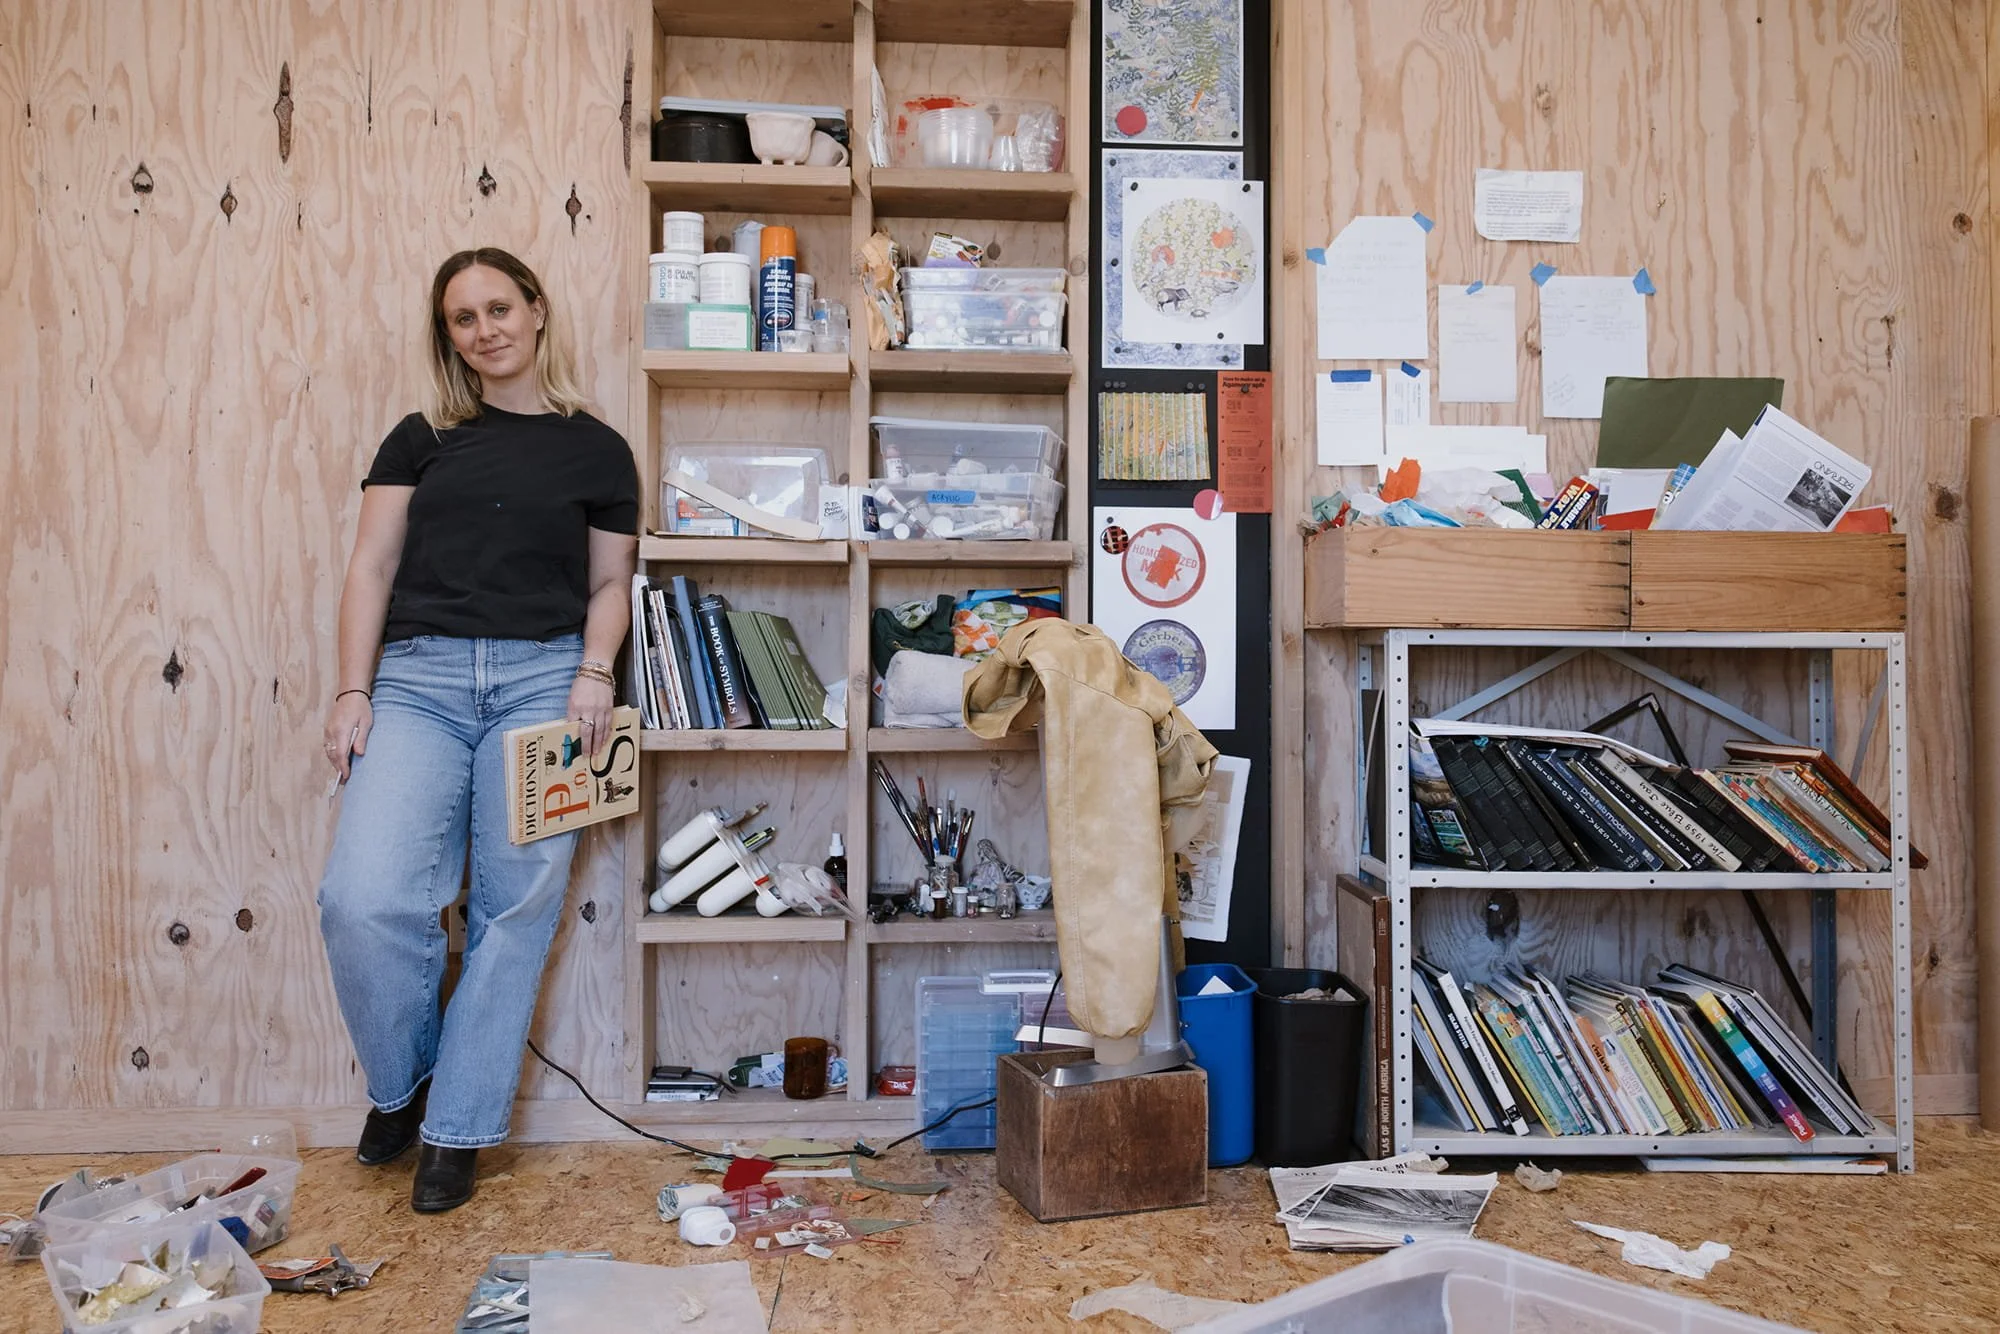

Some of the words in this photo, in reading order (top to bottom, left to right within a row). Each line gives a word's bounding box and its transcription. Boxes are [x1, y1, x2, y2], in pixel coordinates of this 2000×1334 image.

[1554, 484, 1581, 513] Wax
[1560, 491, 1592, 529] DURABLE
[1138, 631, 1186, 648] Gerber
[710, 627, 725, 660] BOOK
[719, 665, 739, 714] SYMBOLS
[525, 738, 539, 836] DICTIONARY
[1635, 780, 1661, 803] Jay
[1525, 753, 1573, 803] CREIGHTON
[1572, 801, 1625, 856] UNIVERSITY
[1587, 759, 1637, 805] CREIGHTON
[1637, 803, 1692, 854] UNIVERSITY
[1656, 800, 1685, 825] Blue
[1705, 841, 1730, 863] The
[1380, 1058, 1390, 1094] AMERICA
[1380, 1095, 1390, 1123] NORTH
[1381, 1124, 1389, 1136] OF
